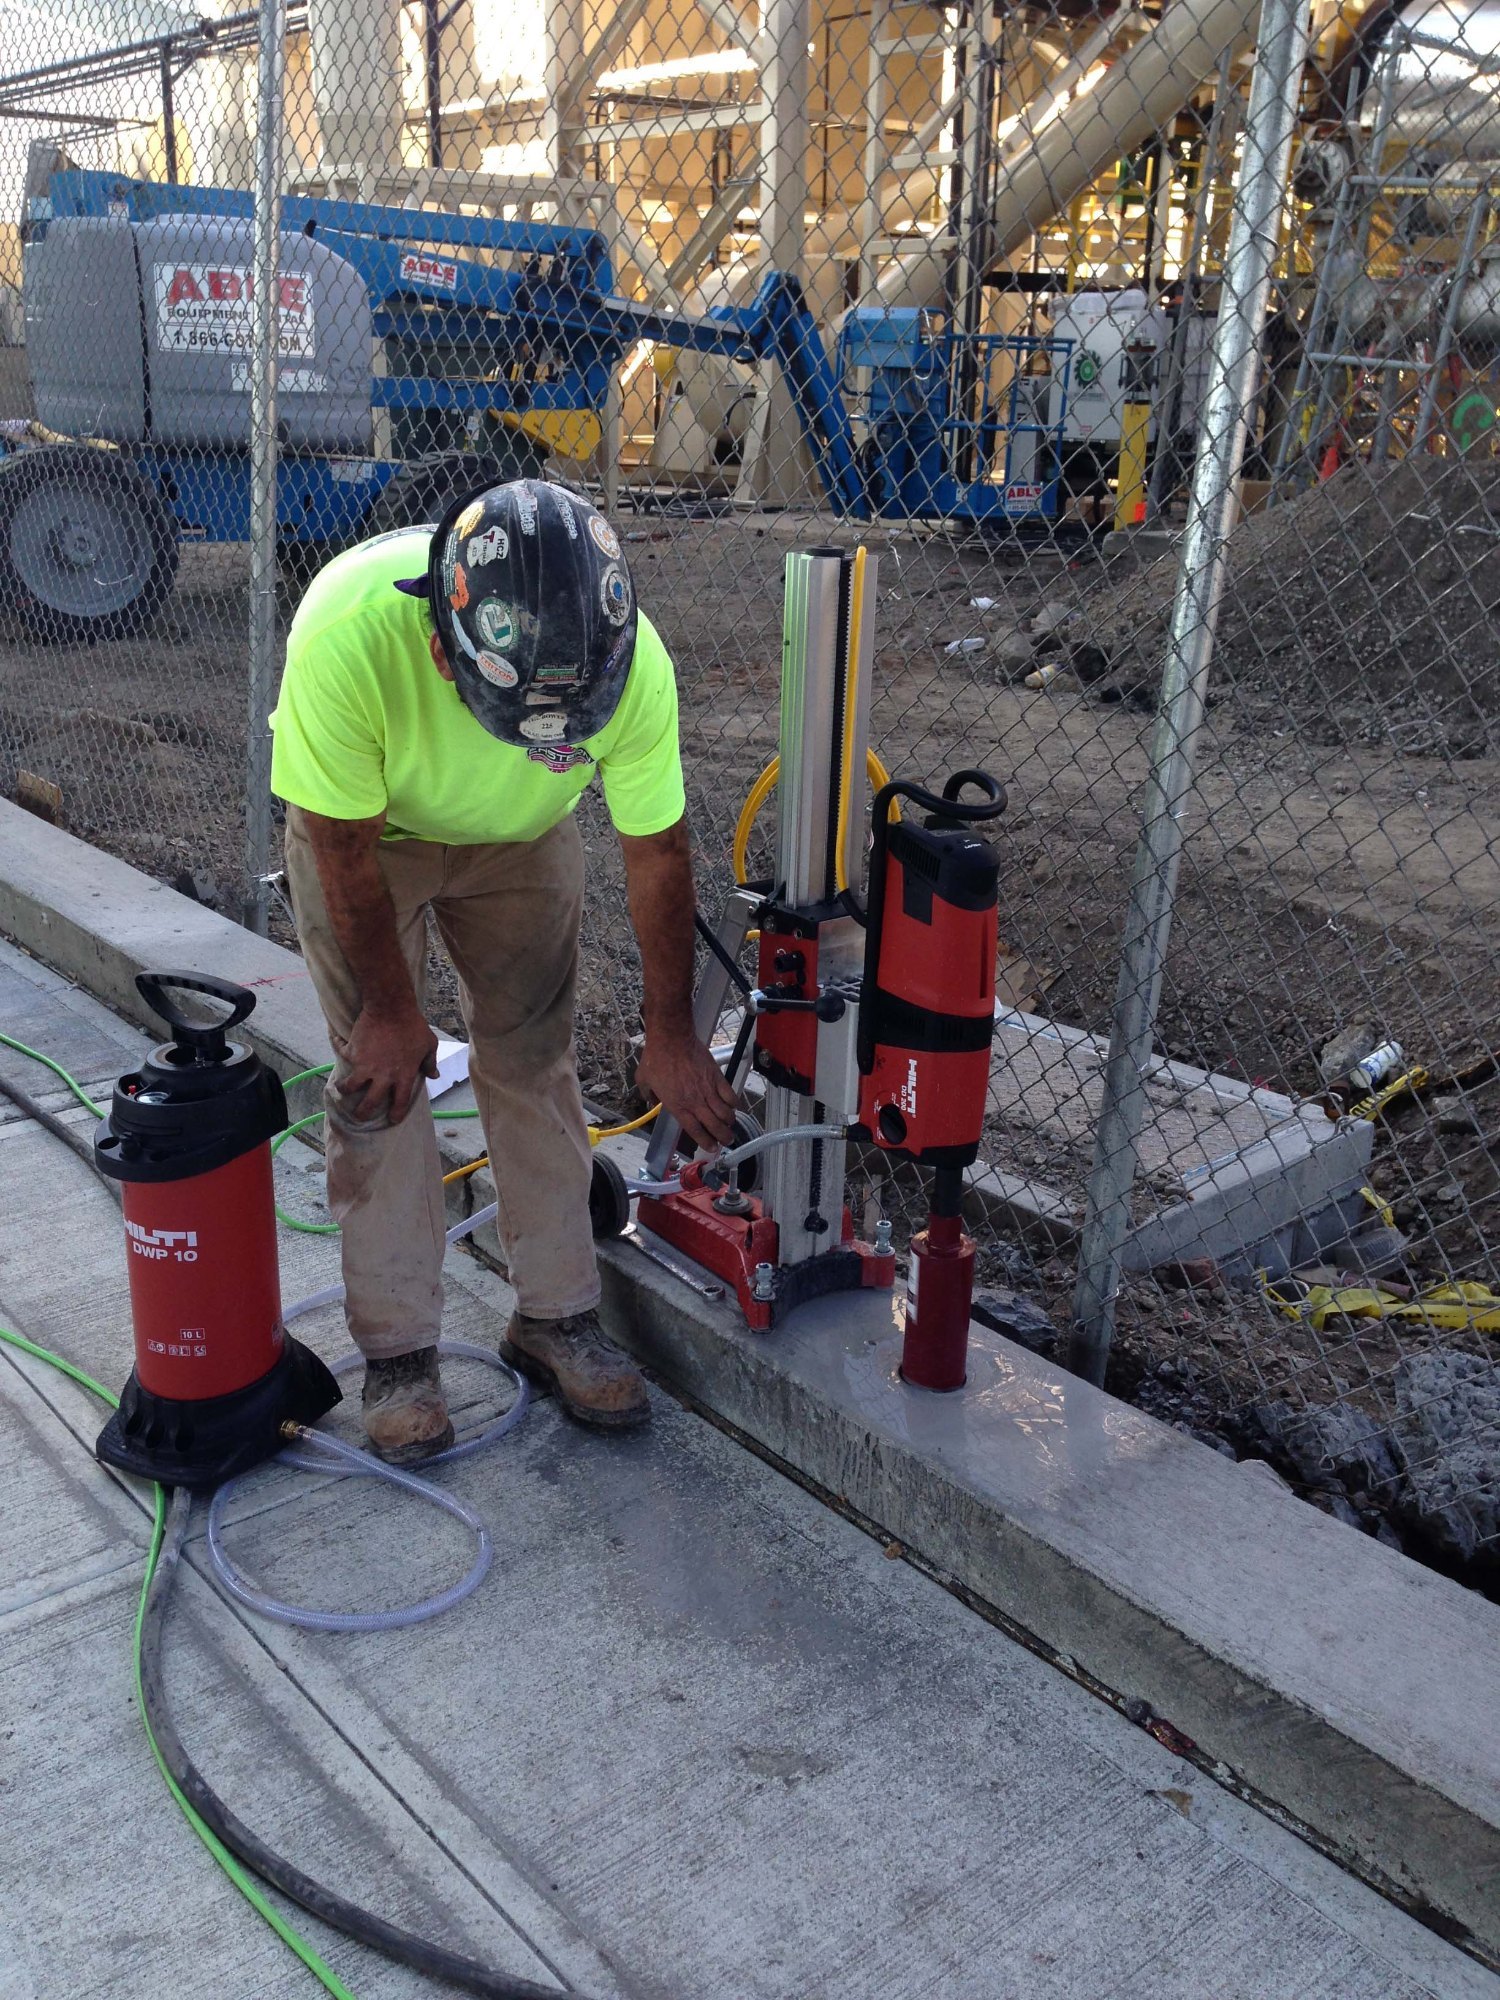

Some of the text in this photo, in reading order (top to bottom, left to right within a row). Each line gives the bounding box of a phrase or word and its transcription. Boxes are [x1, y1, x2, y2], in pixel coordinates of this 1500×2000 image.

[403, 258, 455, 282] ABLE
[165, 269, 306, 314] ABE
[167, 307, 252, 321] EQUIPMENT
[907, 1059, 917, 1114] HILTI
[123, 1218, 198, 1247] HILTI
[132, 1240, 198, 1262] DWP 10
[182, 1331, 202, 1339] 10 L
